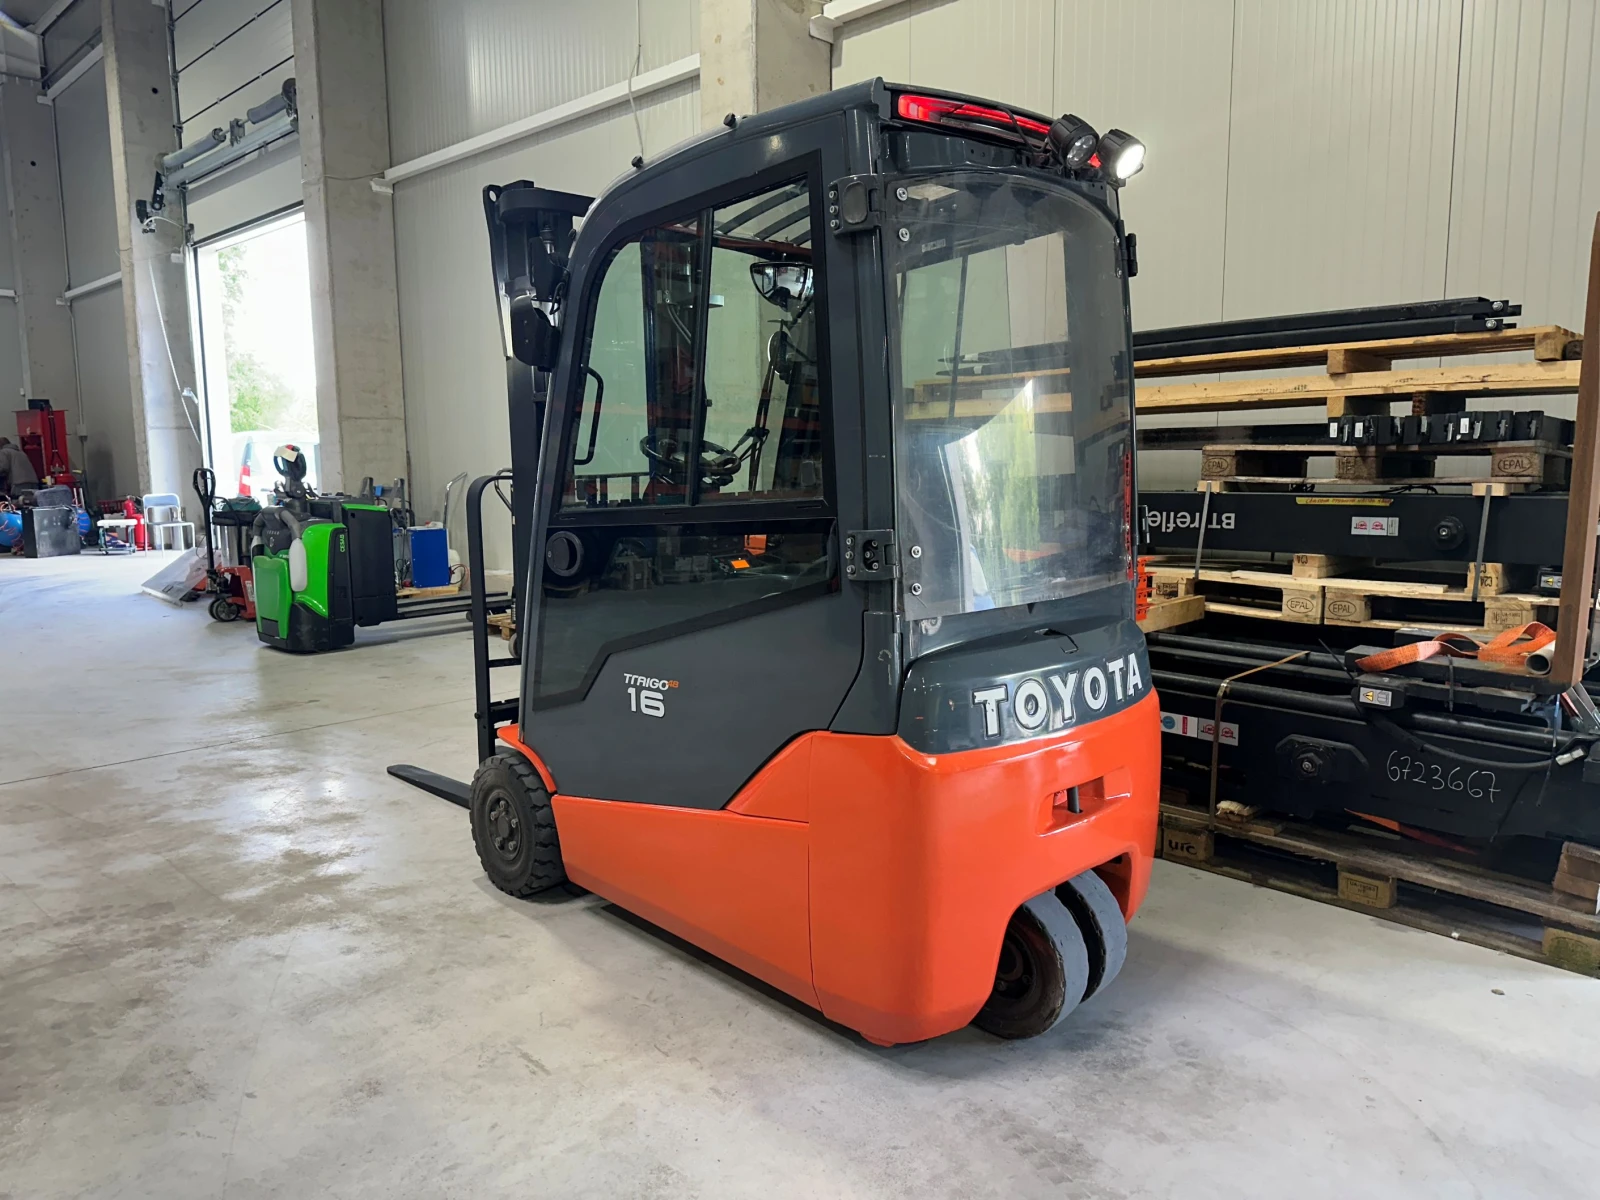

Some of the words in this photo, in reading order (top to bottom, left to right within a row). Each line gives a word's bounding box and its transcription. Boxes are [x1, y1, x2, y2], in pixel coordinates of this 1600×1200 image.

[1503, 459, 1527, 470] EPAL
[1147, 510, 1200, 533] refle
[1207, 512, 1236, 530] BT
[1289, 600, 1310, 611] EPAL
[1332, 603, 1353, 614] EPAL
[627, 686, 665, 718] 16
[973, 652, 1143, 737] TOYOTA
[1386, 750, 1501, 803] 6723667
